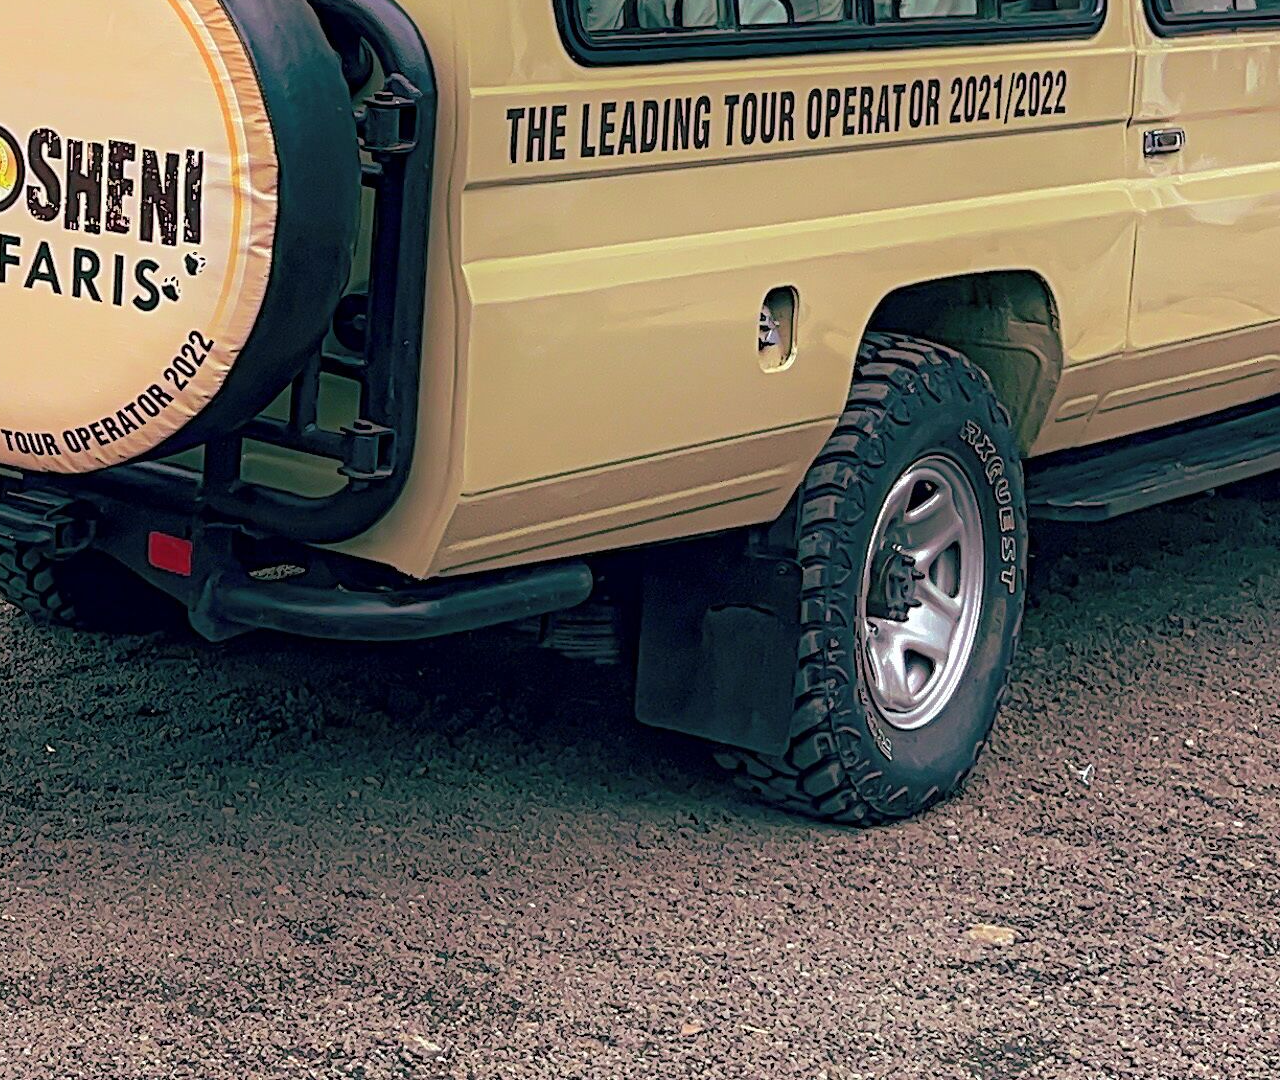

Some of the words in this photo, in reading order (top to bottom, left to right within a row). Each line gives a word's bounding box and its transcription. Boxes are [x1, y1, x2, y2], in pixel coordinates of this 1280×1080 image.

[506, 104, 567, 164] THE
[580, 95, 711, 158] LEADING
[724, 90, 795, 147] TOUR
[806, 78, 940, 140] OPERATOR
[950, 69, 1068, 124] 2021/2022
[0, 428, 62, 457] TOUR
[61, 383, 175, 453] OPERATOR
[163, 330, 215, 392] 2022
